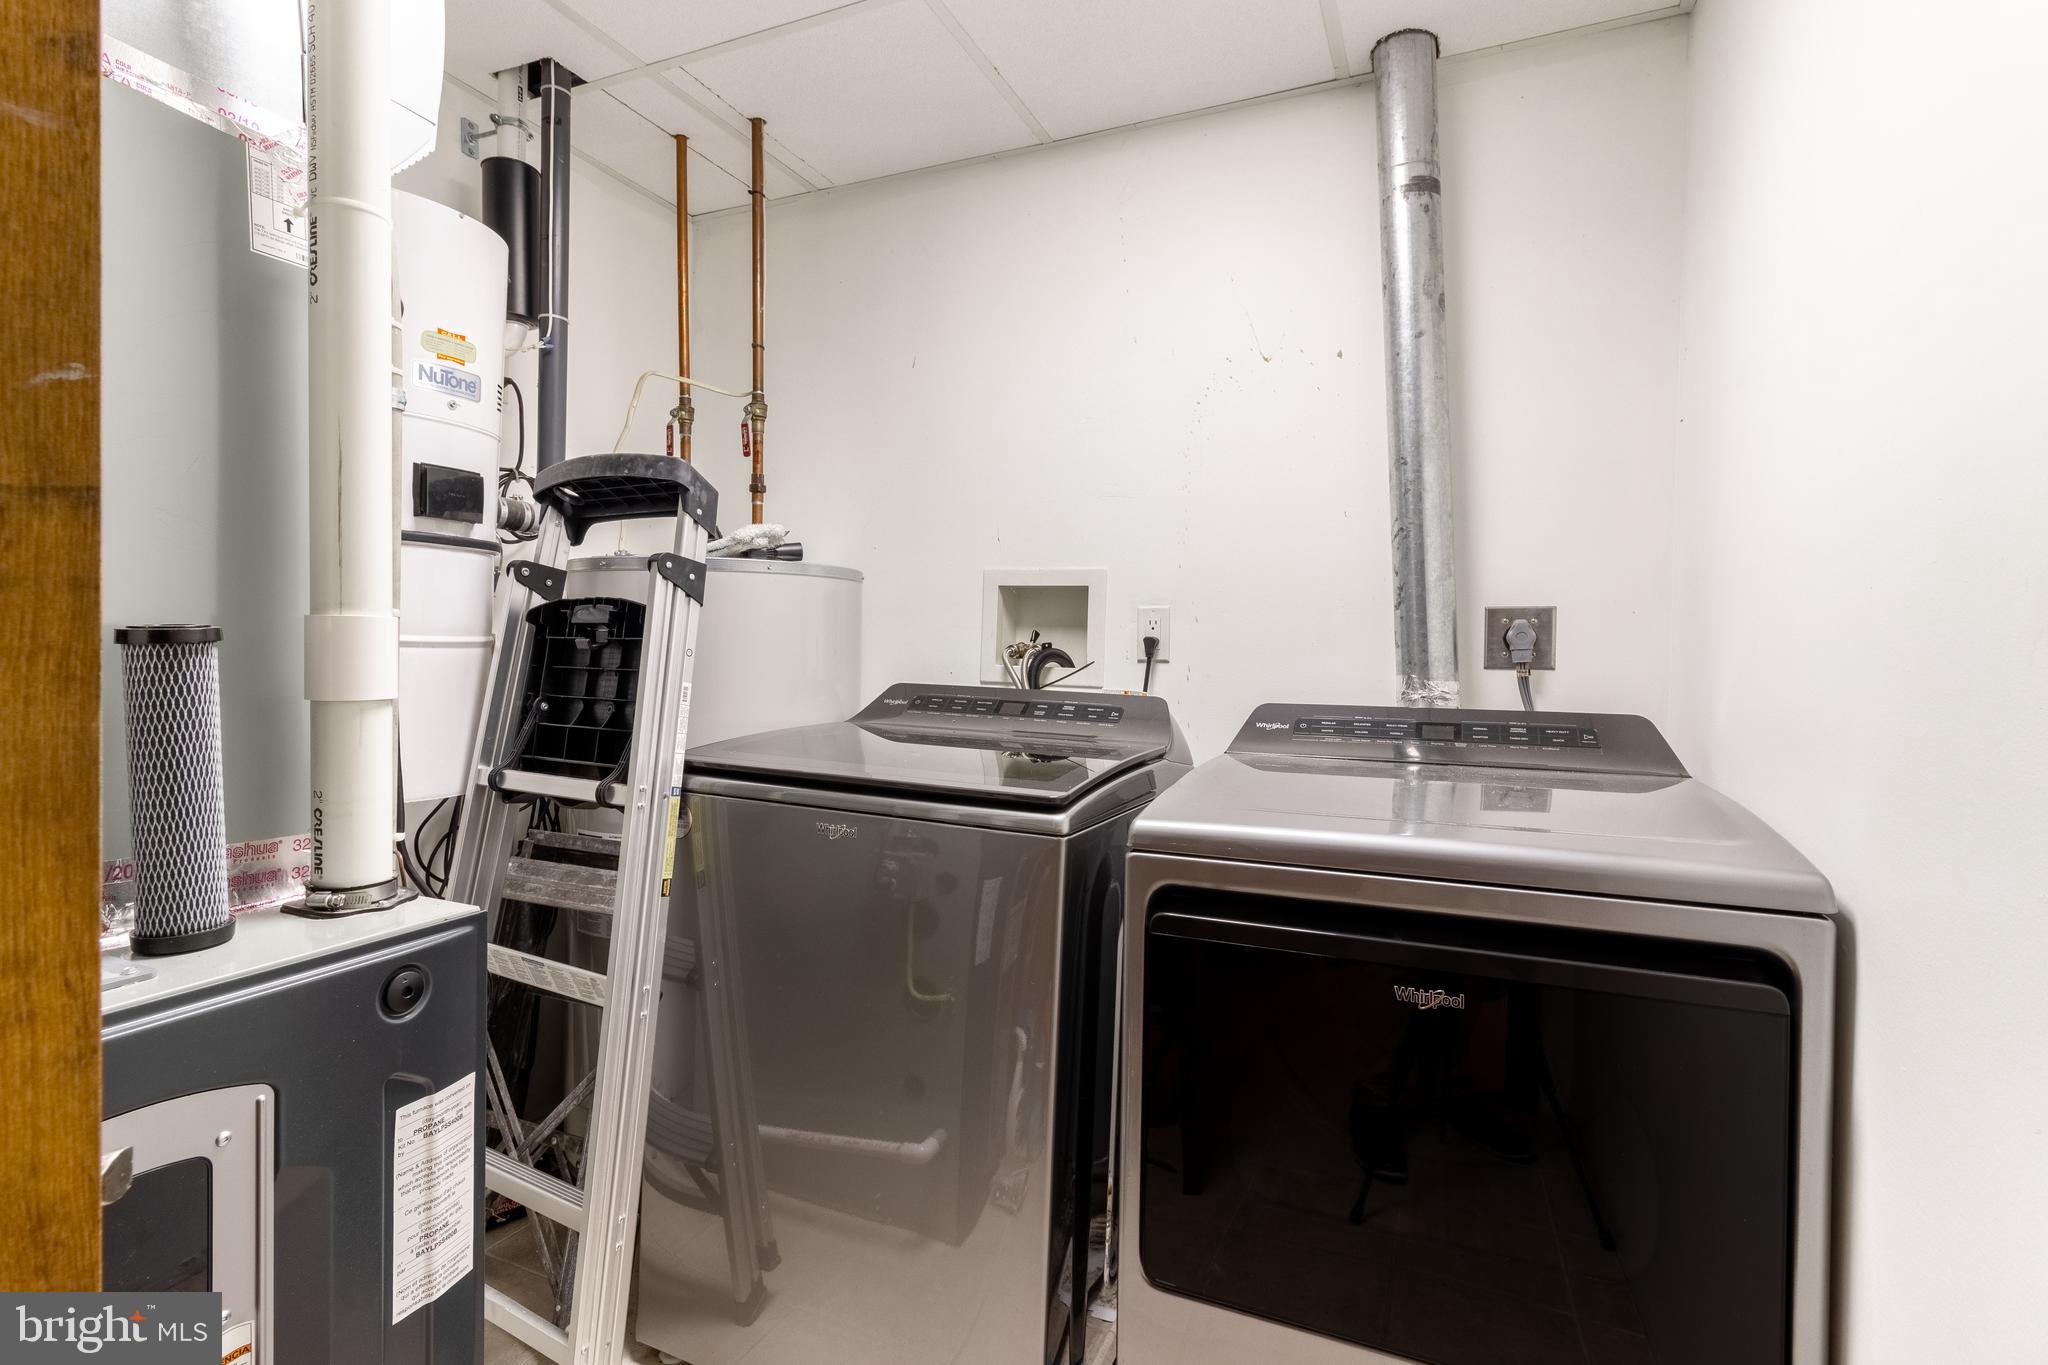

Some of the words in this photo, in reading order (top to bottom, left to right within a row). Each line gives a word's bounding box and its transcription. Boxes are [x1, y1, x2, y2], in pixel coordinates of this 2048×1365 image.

[308, 4, 316, 22] 40
[308, 25, 317, 52] SCH
[308, 155, 317, 181] DWV
[308, 216, 318, 286] CRESLINE
[418, 363, 476, 393] NuTone
[1256, 721, 1289, 730] Whirlpool
[226, 841, 279, 859] ashua
[313, 808, 323, 876] CRESLINE
[1394, 985, 1465, 1010] Whirlpool
[413, 1117, 444, 1135] PROPANE
[419, 1220, 449, 1242] PROPANE
